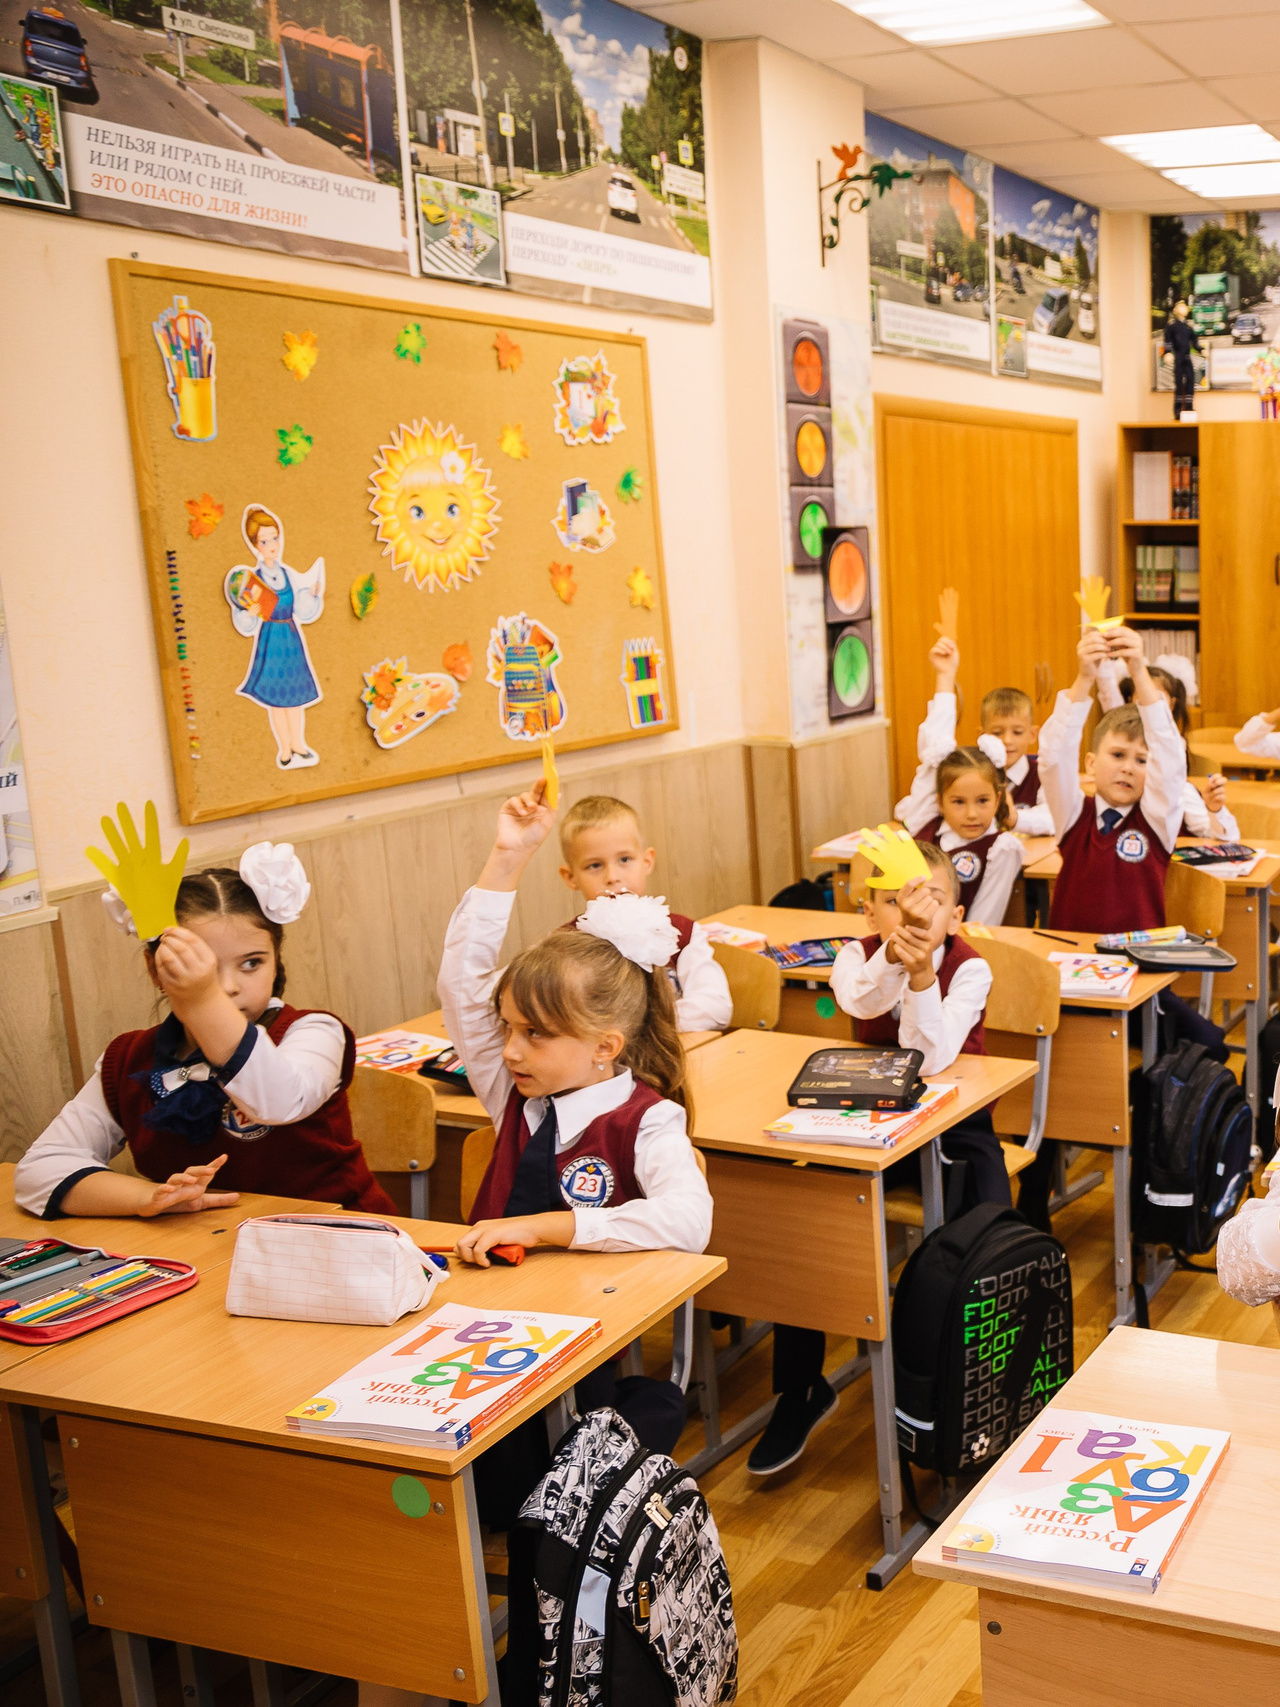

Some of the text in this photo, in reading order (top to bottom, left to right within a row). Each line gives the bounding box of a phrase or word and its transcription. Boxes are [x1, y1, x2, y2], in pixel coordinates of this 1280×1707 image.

[86, 126, 376, 203] НЕЛЬЗЯ ИГРАТЬ НА ПРОЕЗЖЕЙ ЧАСТИ
[89, 150, 247, 196] ИЛИ РЯДОМ С НЕЙ.
[91, 172, 308, 228] ЭТО ОПАСНО ДЛЯ ЖИЗНИ!
[577, 1176, 598, 1193] 23
[361, 1381, 436, 1399] язык
[366, 1393, 462, 1416] Русский
[1018, 1434, 1074, 1474] 1
[1008, 1504, 1094, 1527] язык
[1024, 1522, 1138, 1554] Русский
